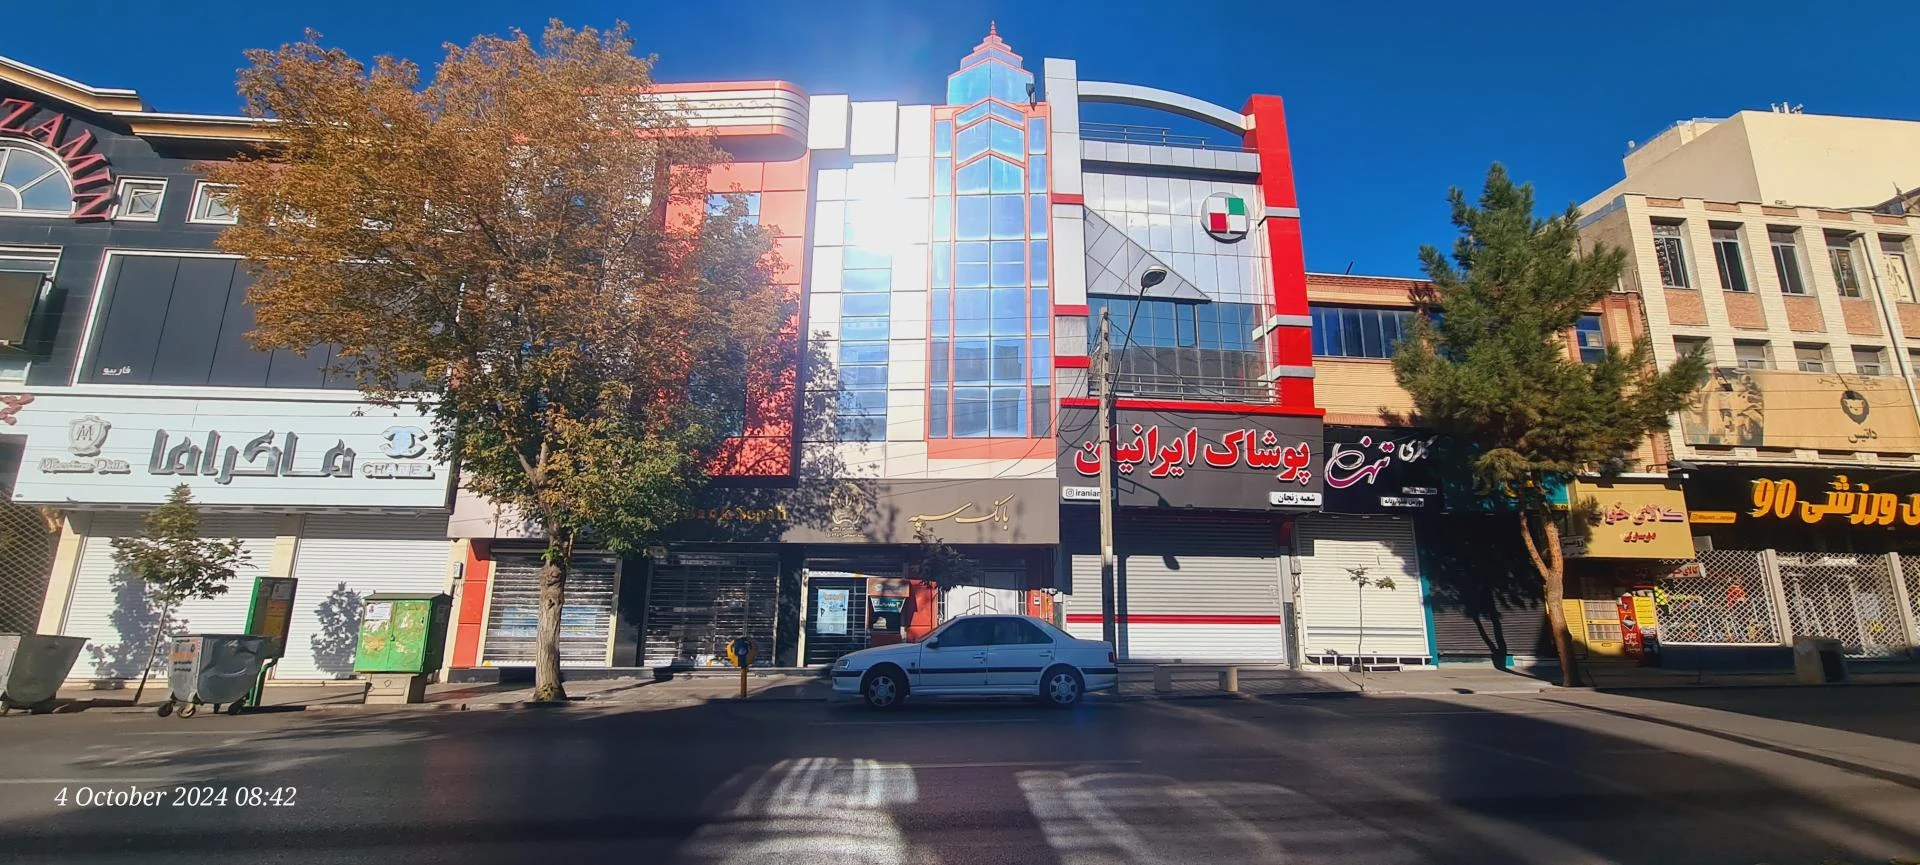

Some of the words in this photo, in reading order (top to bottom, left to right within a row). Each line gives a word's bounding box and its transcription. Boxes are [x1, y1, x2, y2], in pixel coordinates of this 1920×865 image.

[1074, 423, 1199, 477] ایرانیان
[1204, 428, 1315, 486] پوشاک
[908, 501, 973, 532] سپه
[955, 492, 1015, 531] بانک
[1277, 492, 1299, 504] زنجان
[1299, 493, 1316, 504] شعبه
[1747, 477, 1797, 519] 90
[1799, 474, 1898, 526] ورزشی
